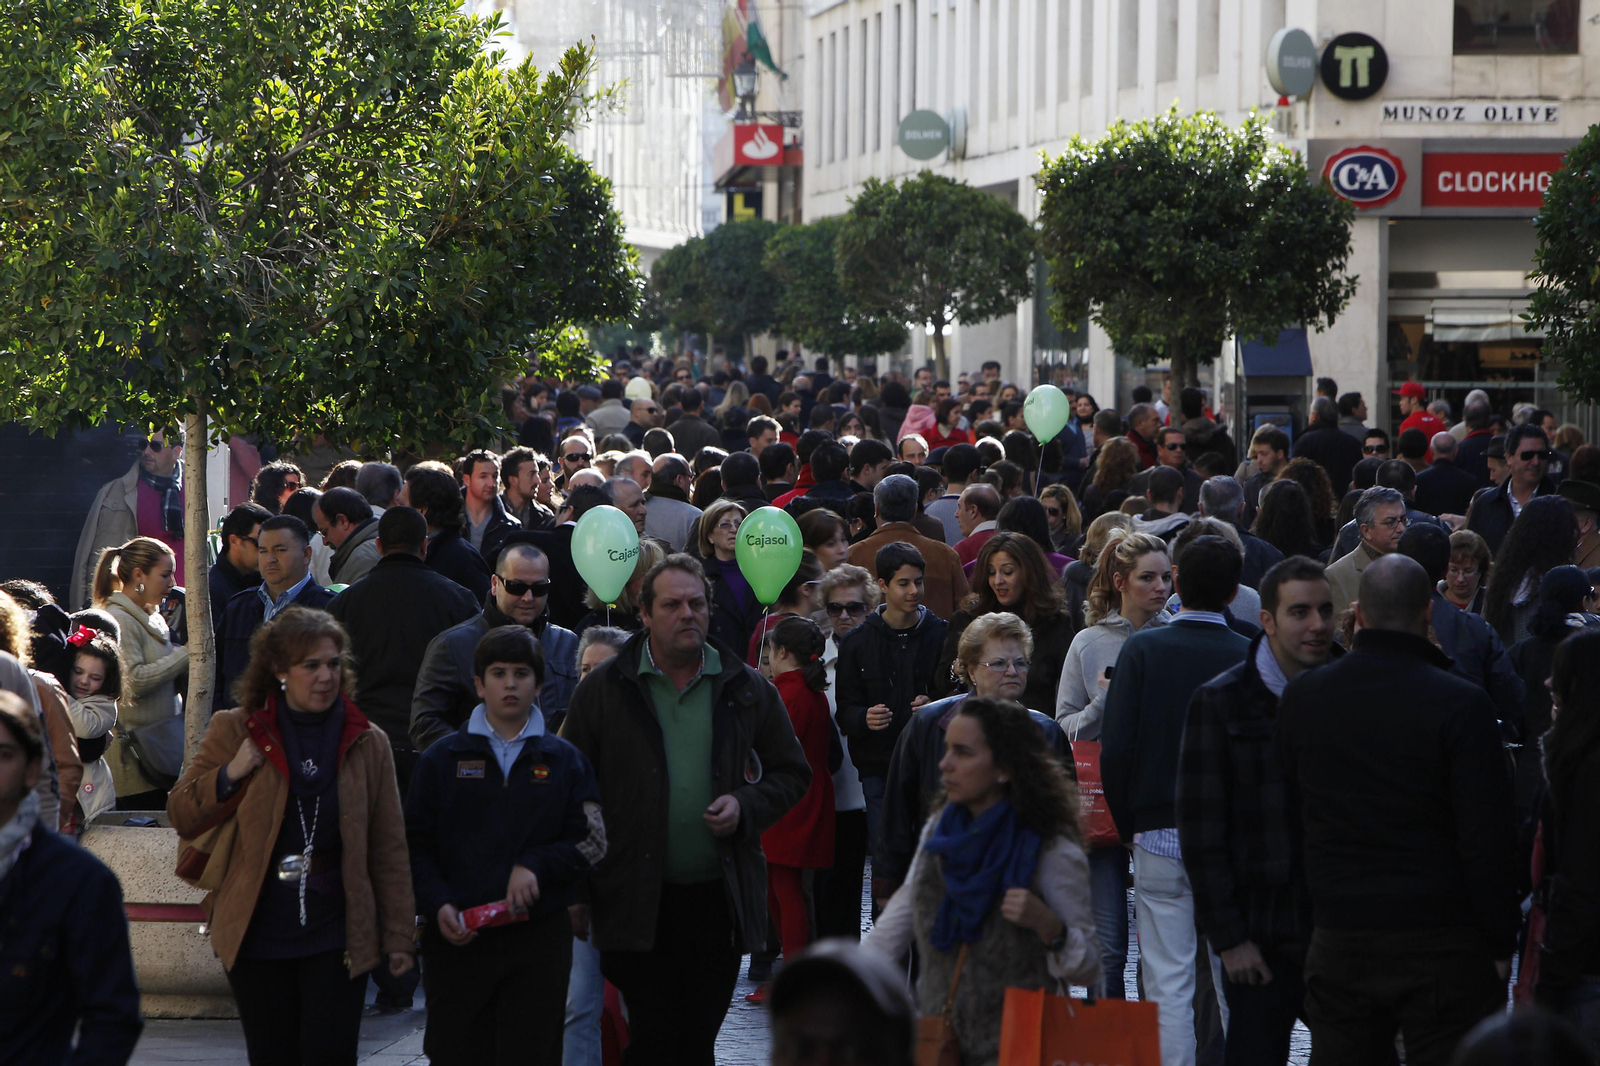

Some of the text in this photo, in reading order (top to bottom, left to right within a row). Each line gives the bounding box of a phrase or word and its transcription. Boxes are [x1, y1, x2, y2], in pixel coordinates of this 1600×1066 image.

[1338, 163, 1389, 190] C&A
[1438, 171, 1552, 192] CLOCKHO
[746, 534, 788, 548] Cajasol
